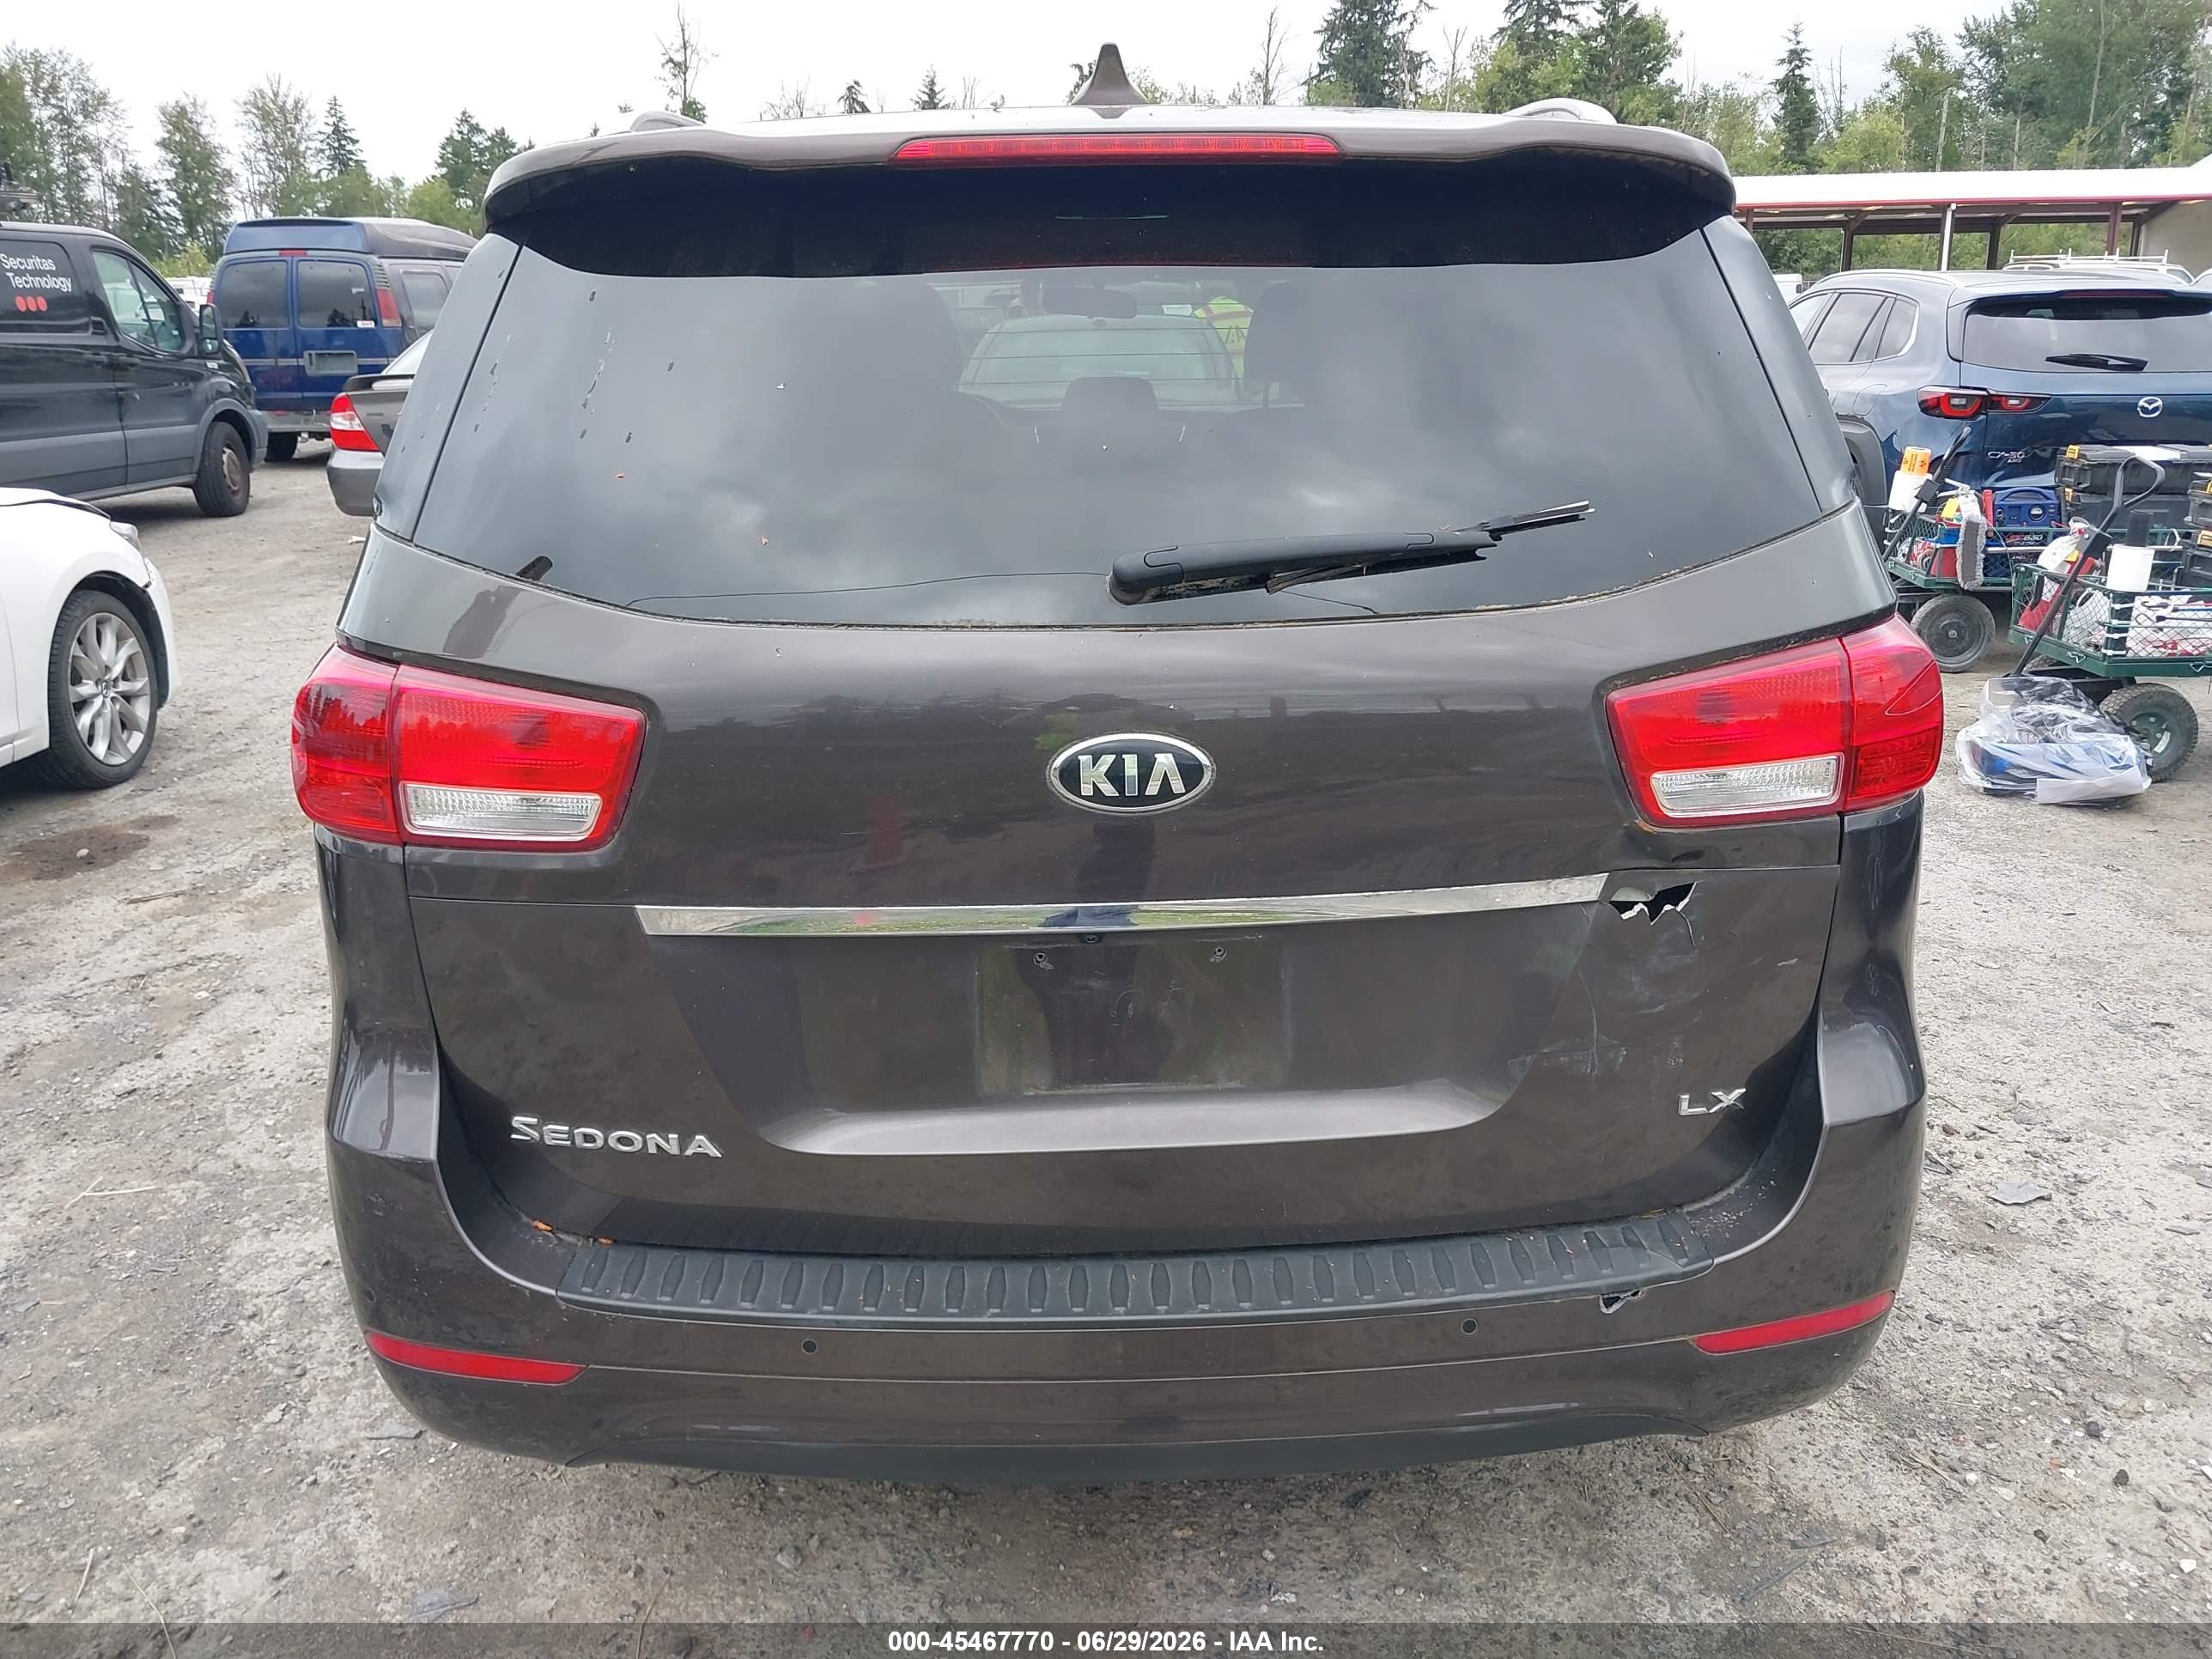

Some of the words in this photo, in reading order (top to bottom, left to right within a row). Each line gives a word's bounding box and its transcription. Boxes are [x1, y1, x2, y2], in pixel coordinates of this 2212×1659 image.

[0, 253, 56, 270] Securitas
[6, 272, 71, 292] Technology
[1078, 753, 1186, 796] KIA
[1678, 1088, 1747, 1115] LX
[510, 1116, 722, 1158] SEDONA
